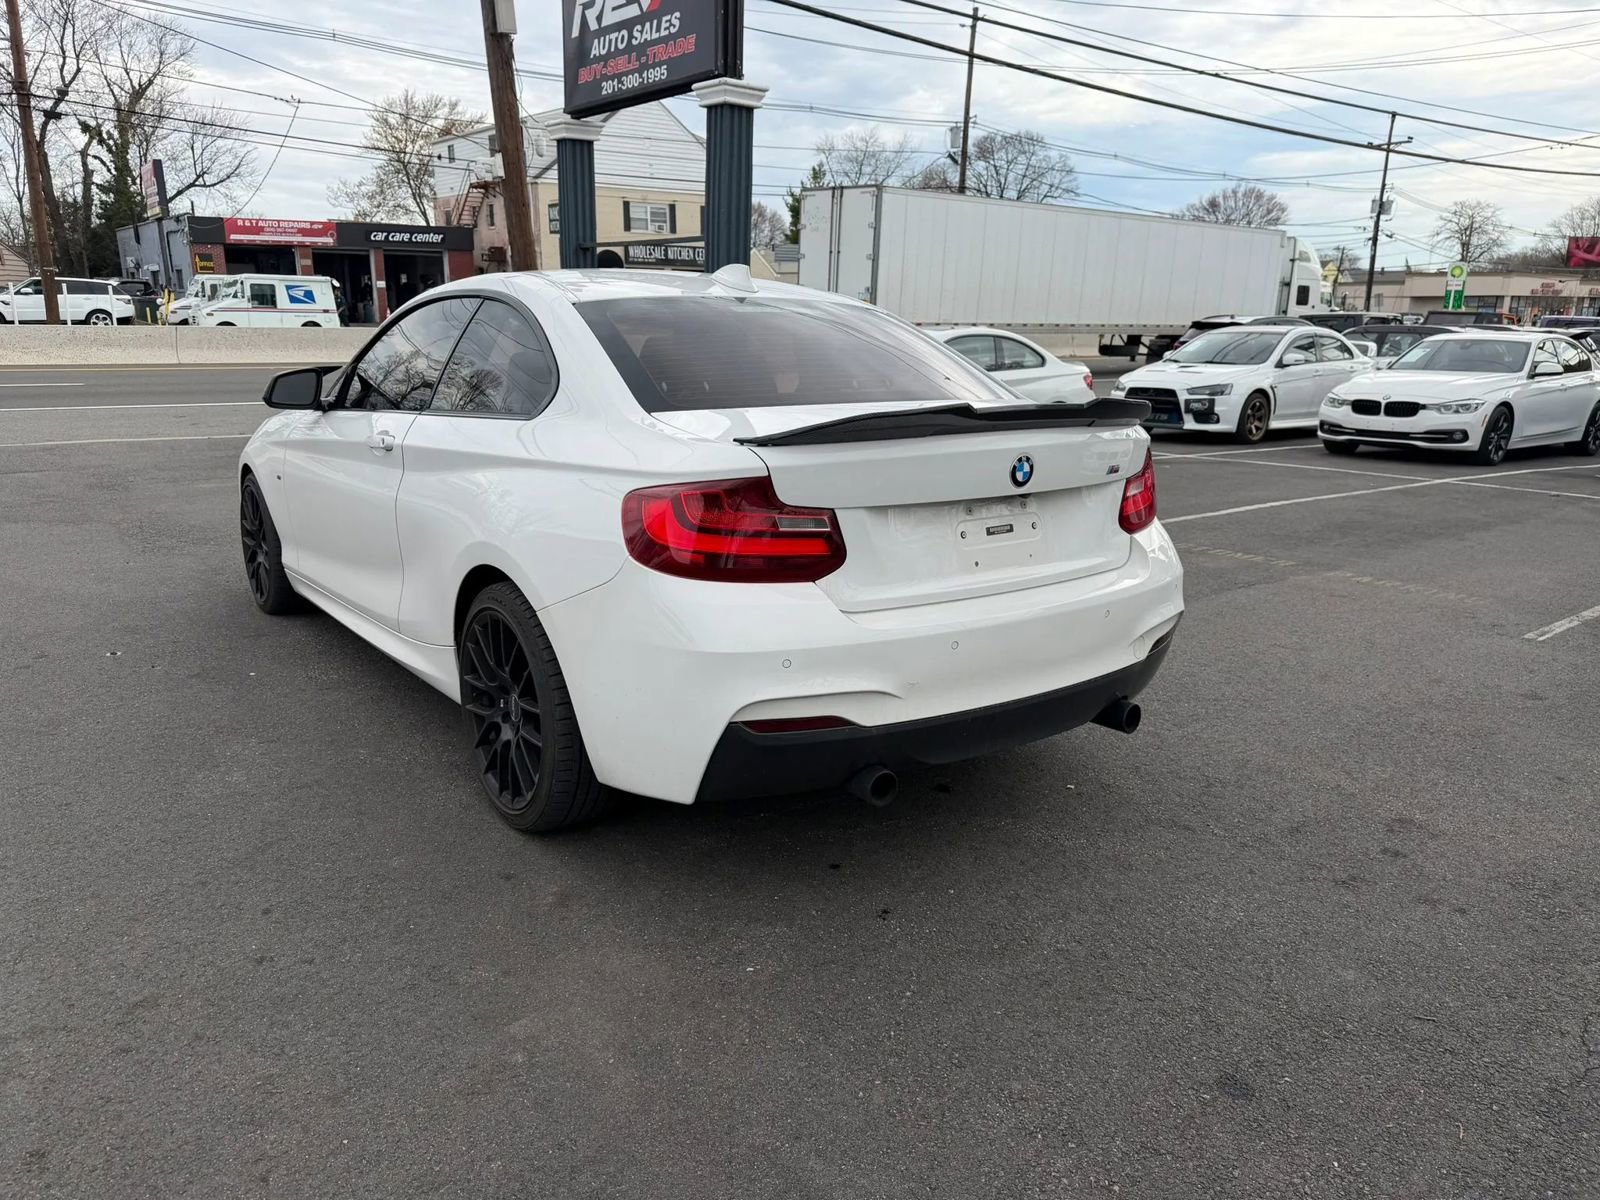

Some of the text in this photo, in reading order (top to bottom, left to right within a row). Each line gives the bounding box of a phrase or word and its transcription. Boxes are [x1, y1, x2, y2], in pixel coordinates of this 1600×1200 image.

[571, 0, 662, 39] RE
[590, 11, 681, 58] AUTO SALES
[601, 65, 668, 95] 201-300-1995
[279, 221, 311, 229] REPAIRS
[370, 231, 444, 243] car care center
[628, 245, 666, 259] WHOLESALE
[667, 246, 694, 260] KITCHEN
